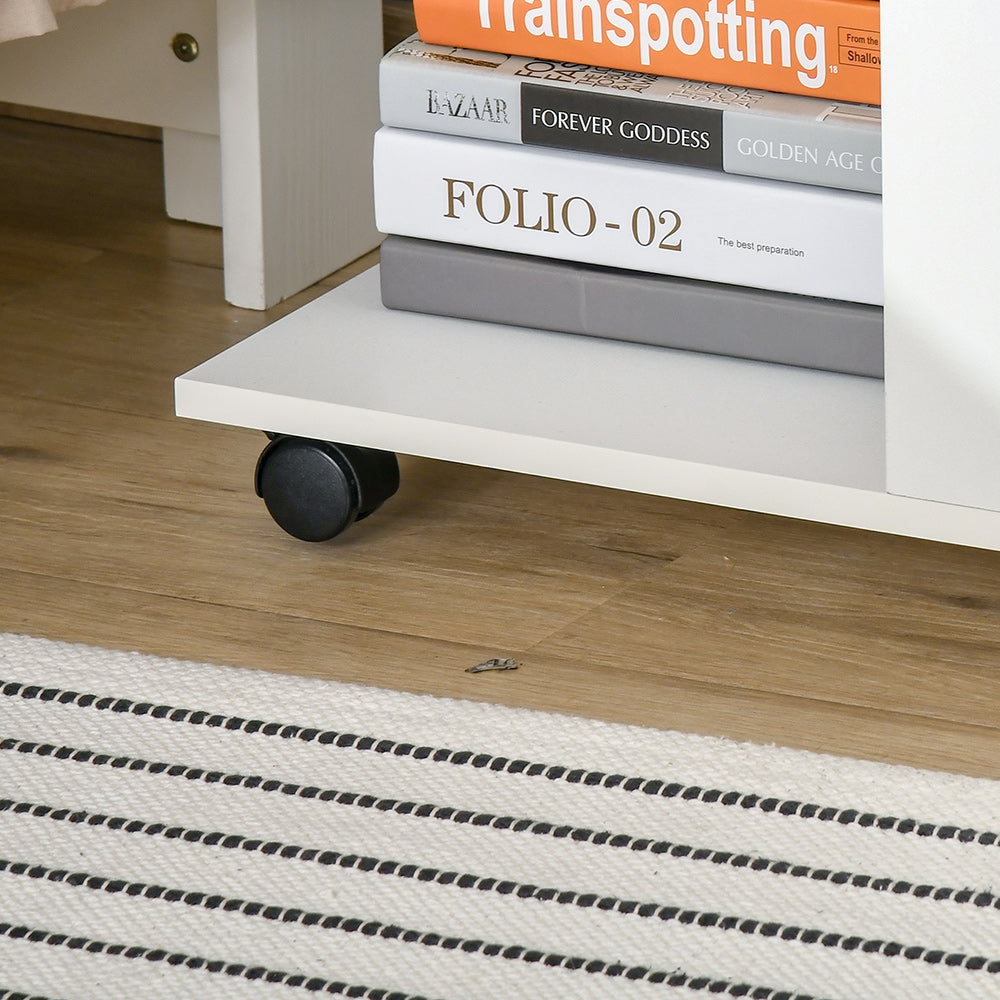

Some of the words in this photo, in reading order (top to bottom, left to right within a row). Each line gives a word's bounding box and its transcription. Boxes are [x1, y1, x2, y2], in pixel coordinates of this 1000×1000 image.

[846, 33, 866, 44] From
[867, 37, 879, 46] the
[427, 89, 511, 124] BAZAAR
[532, 109, 613, 137] FOREVER
[619, 120, 711, 150] GODDESS
[737, 137, 818, 165] GOLDEN
[825, 149, 864, 172] AGE
[442, 177, 598, 238] FOLIO
[631, 205, 683, 253] 02
[718, 236, 734, 248] The
[736, 239, 755, 251] best
[756, 244, 805, 258] preparation
